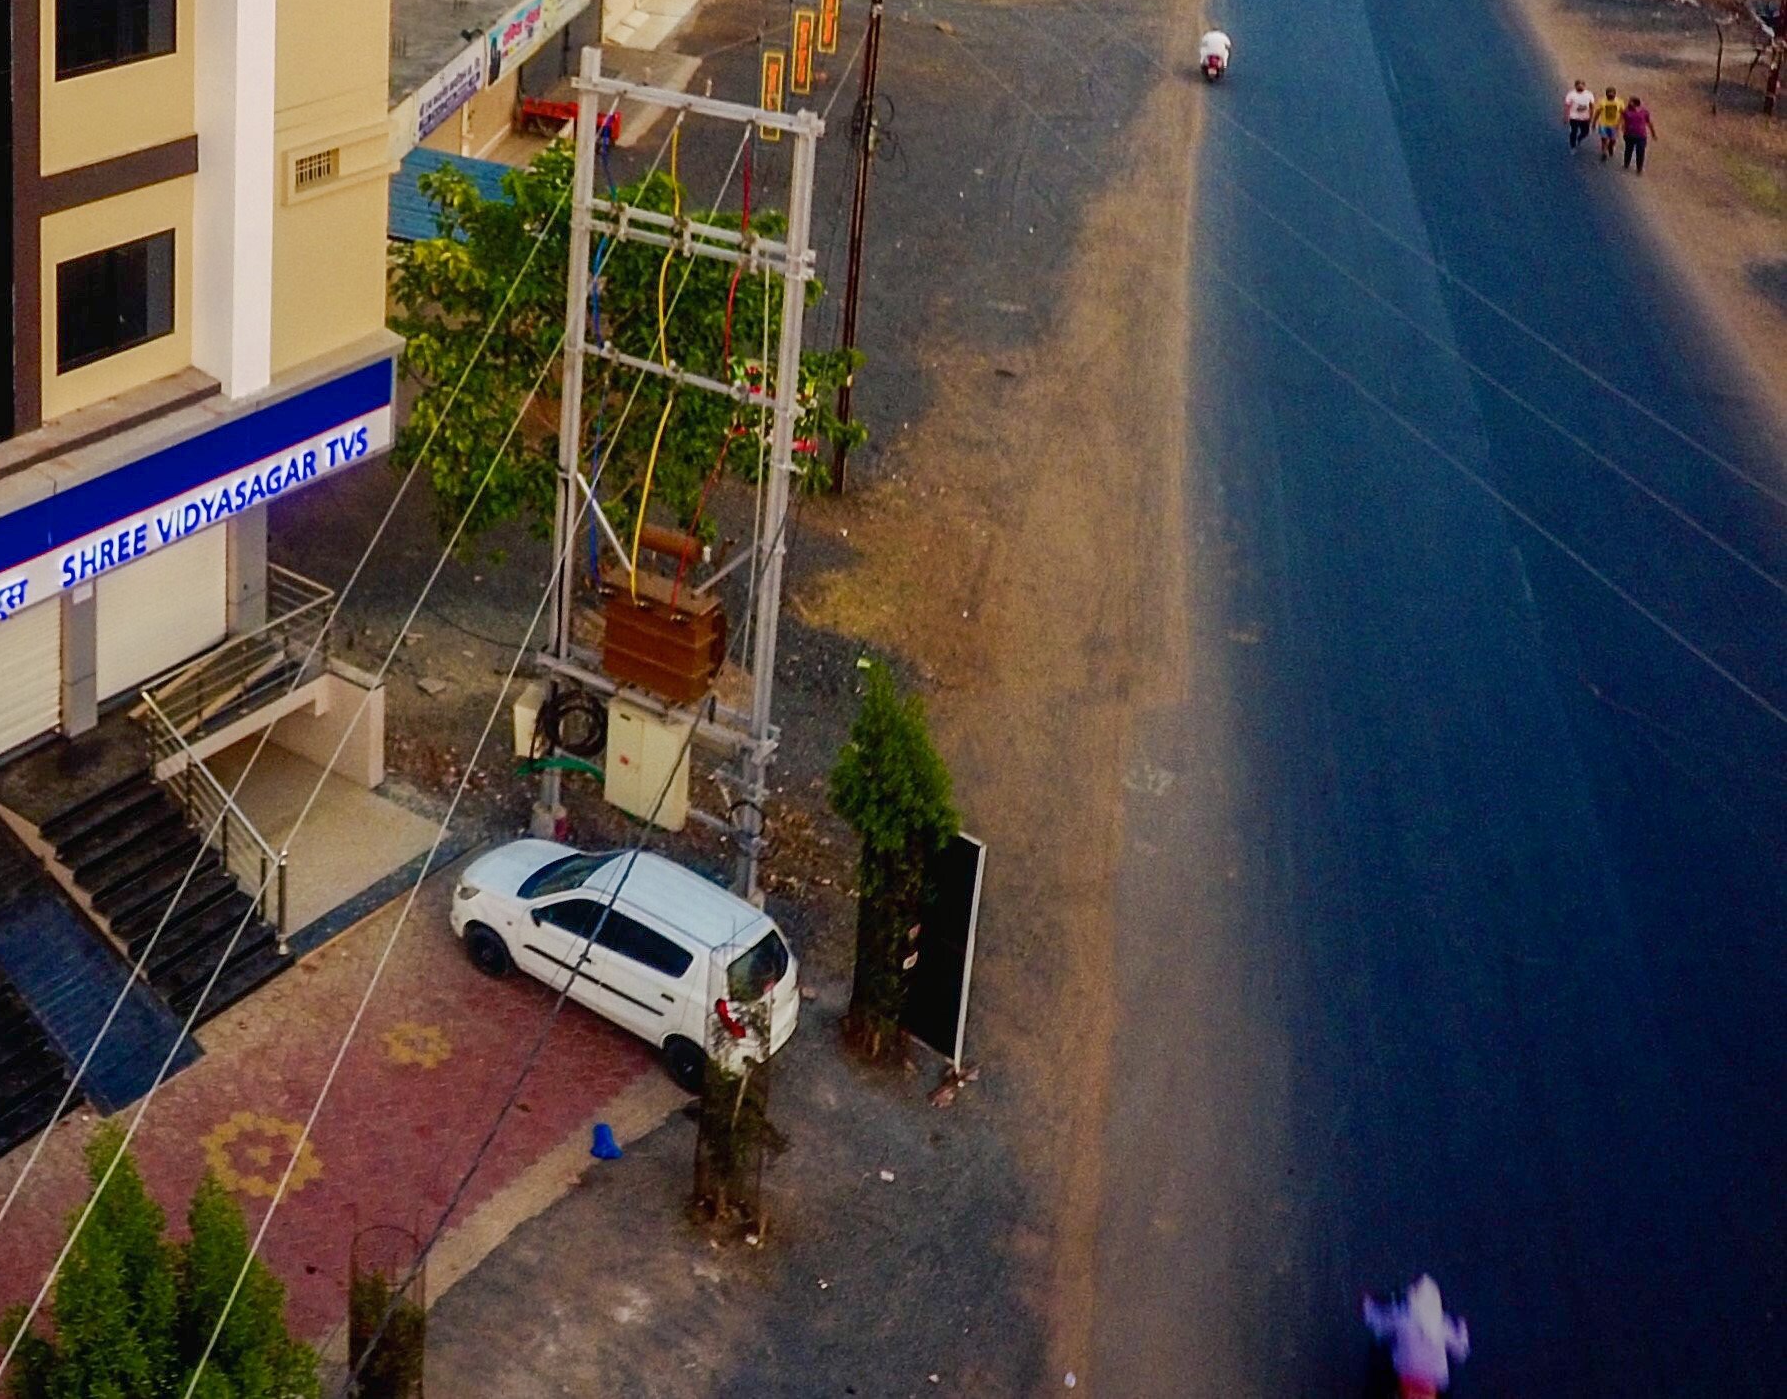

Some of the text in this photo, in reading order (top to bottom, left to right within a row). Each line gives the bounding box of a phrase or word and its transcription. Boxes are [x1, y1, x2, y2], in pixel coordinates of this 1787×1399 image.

[61, 426, 369, 587] SHREE VIDYASAGAR TVS
